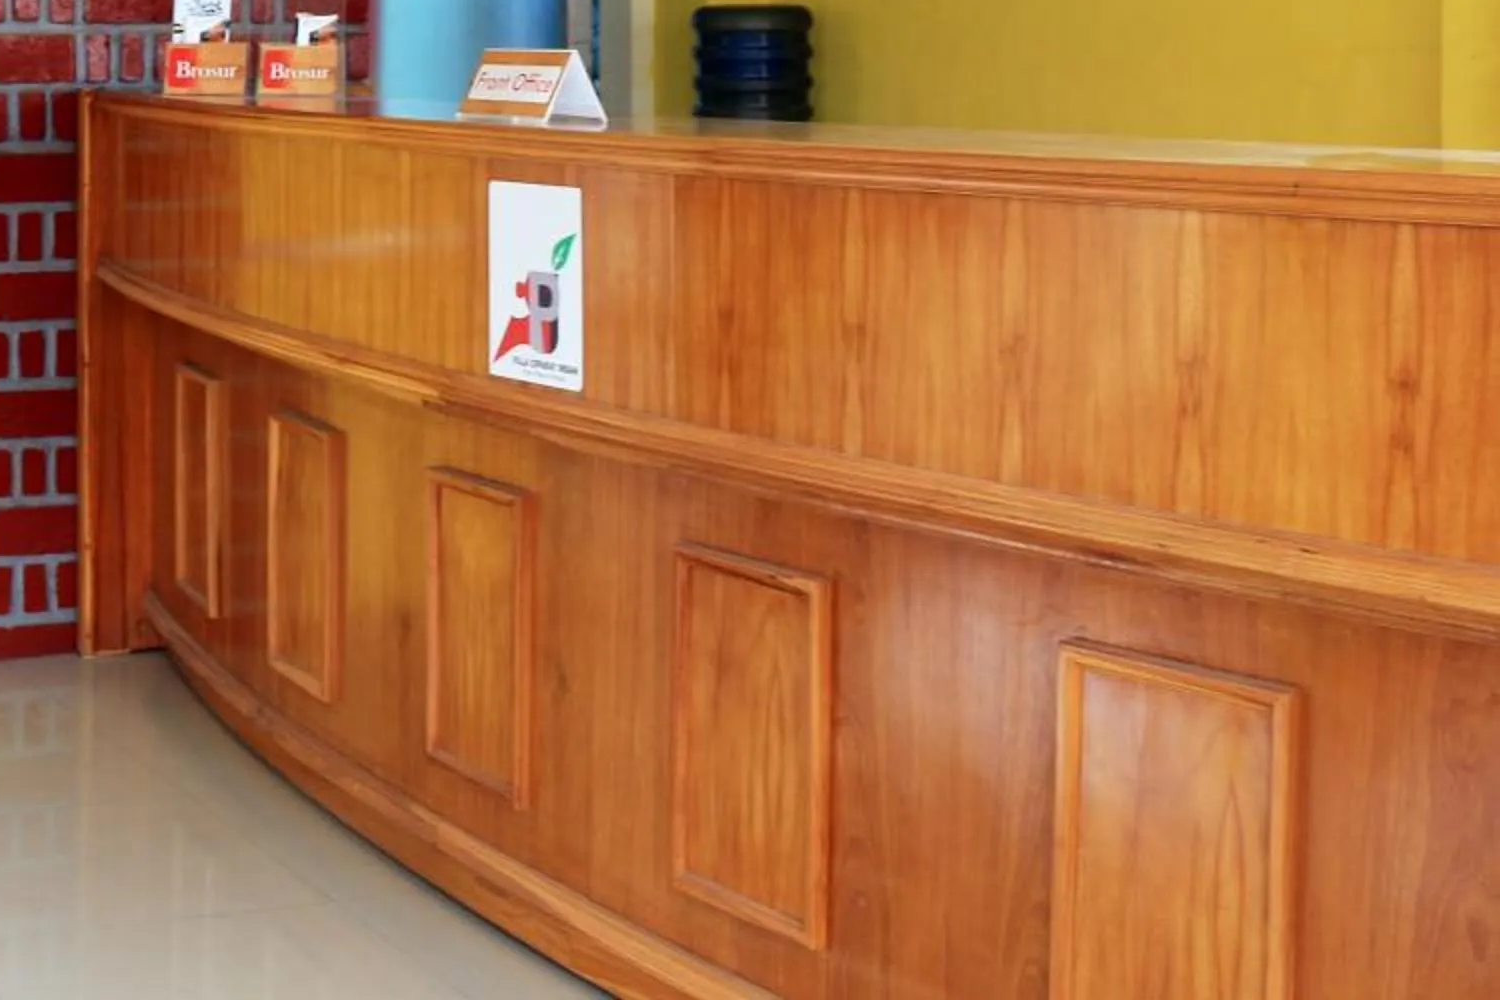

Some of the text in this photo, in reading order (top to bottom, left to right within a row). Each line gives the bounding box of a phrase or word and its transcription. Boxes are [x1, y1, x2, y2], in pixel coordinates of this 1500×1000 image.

[175, 60, 237, 79] Brosur
[271, 62, 330, 80] Brosur
[475, 70, 554, 93] Front Office
